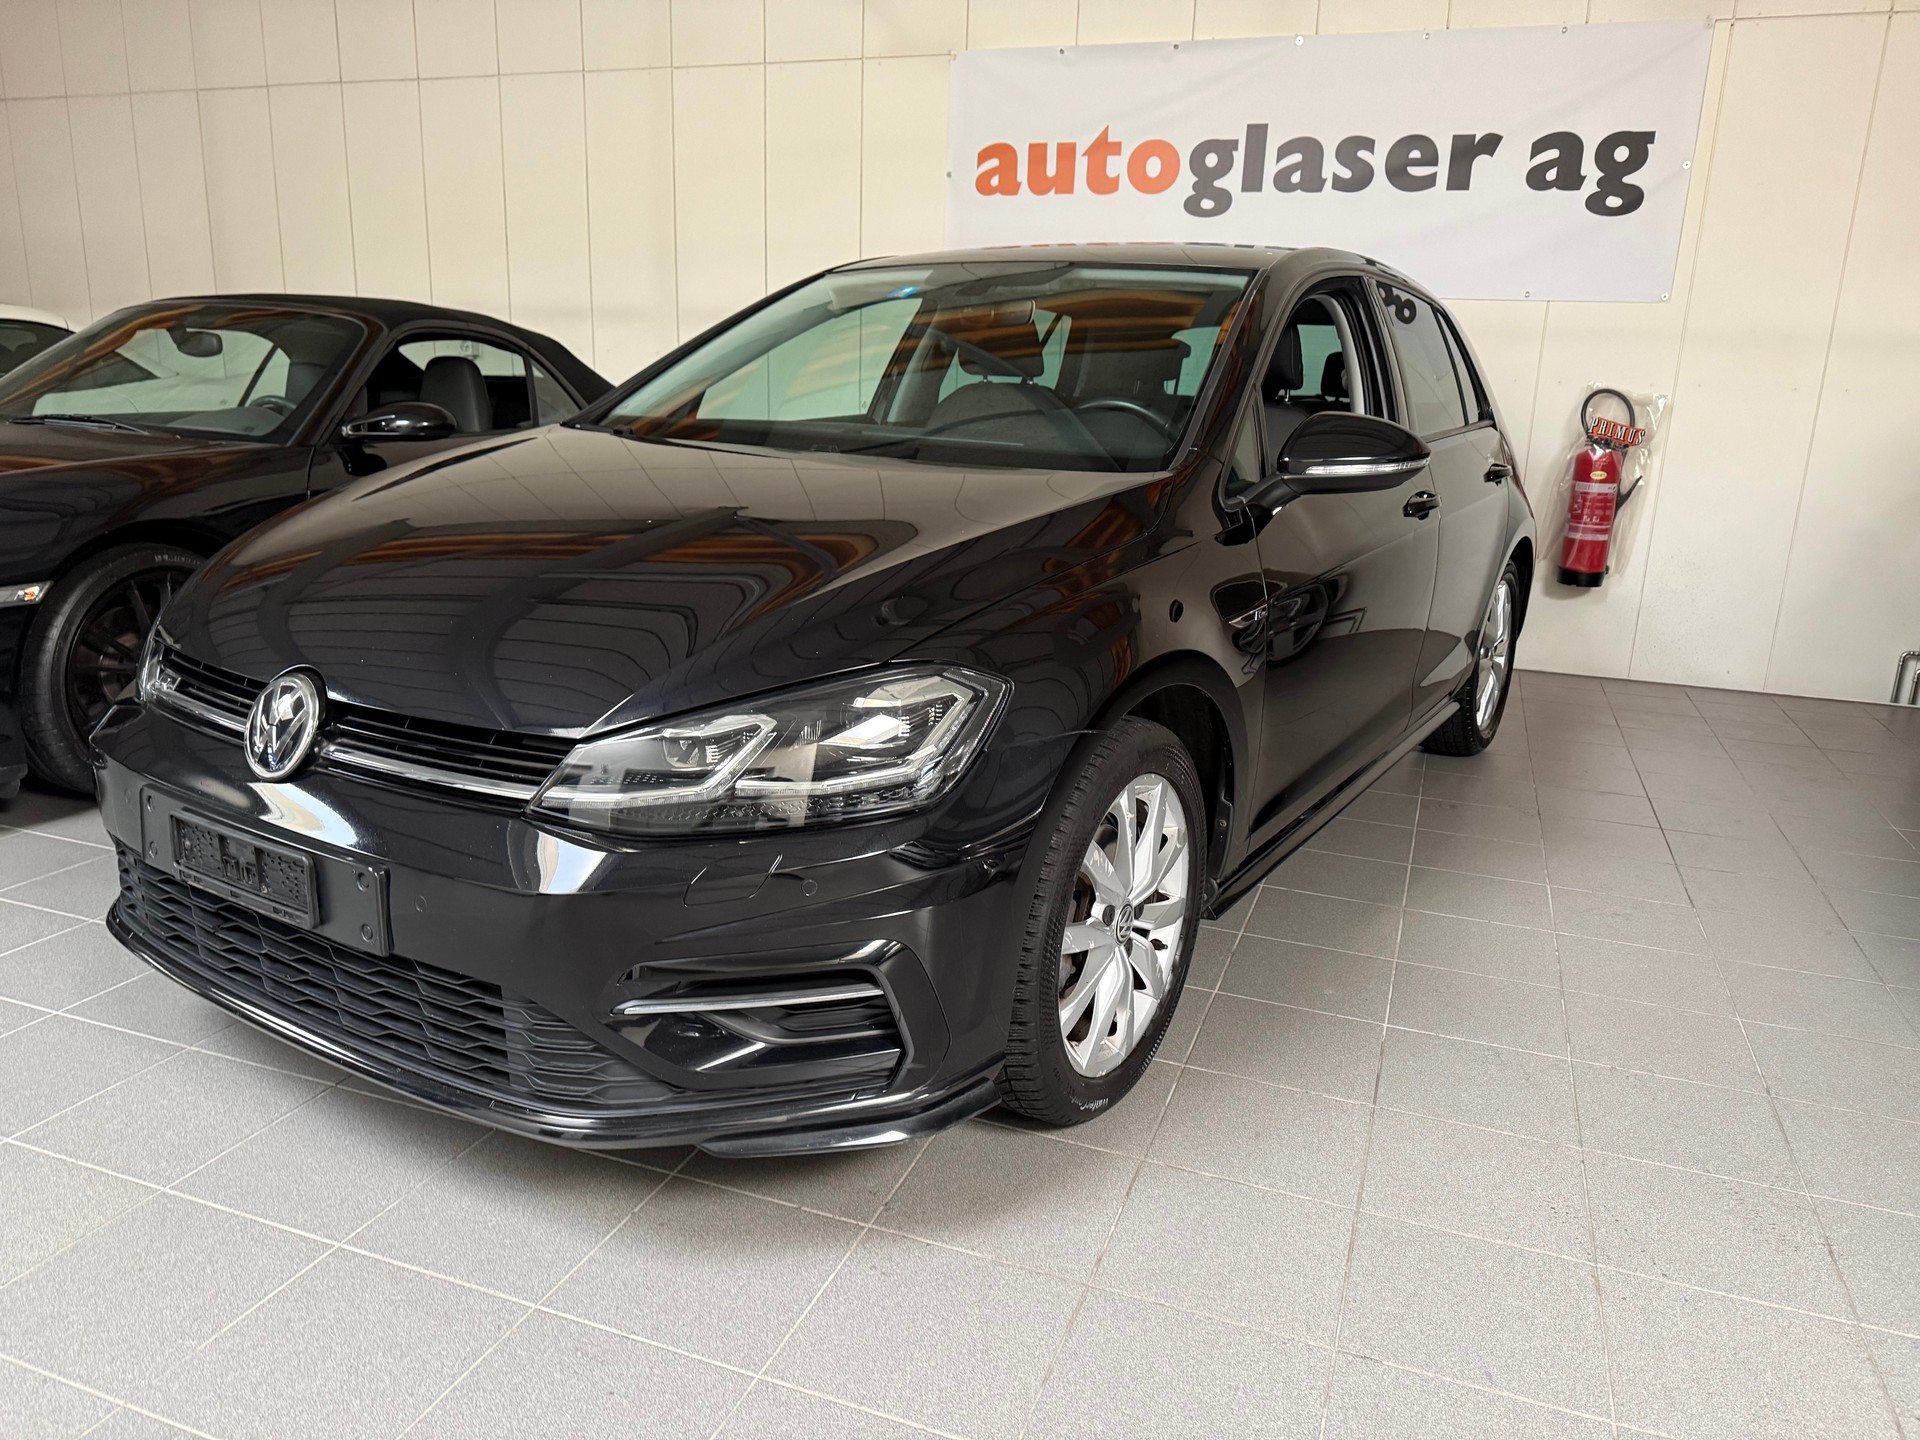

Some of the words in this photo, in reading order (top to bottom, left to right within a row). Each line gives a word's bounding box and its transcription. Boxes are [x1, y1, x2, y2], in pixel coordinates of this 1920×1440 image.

[976, 124, 1503, 217] autoglaser
[1526, 131, 1656, 216] ag
[1588, 417, 1646, 445] PRIMUS
